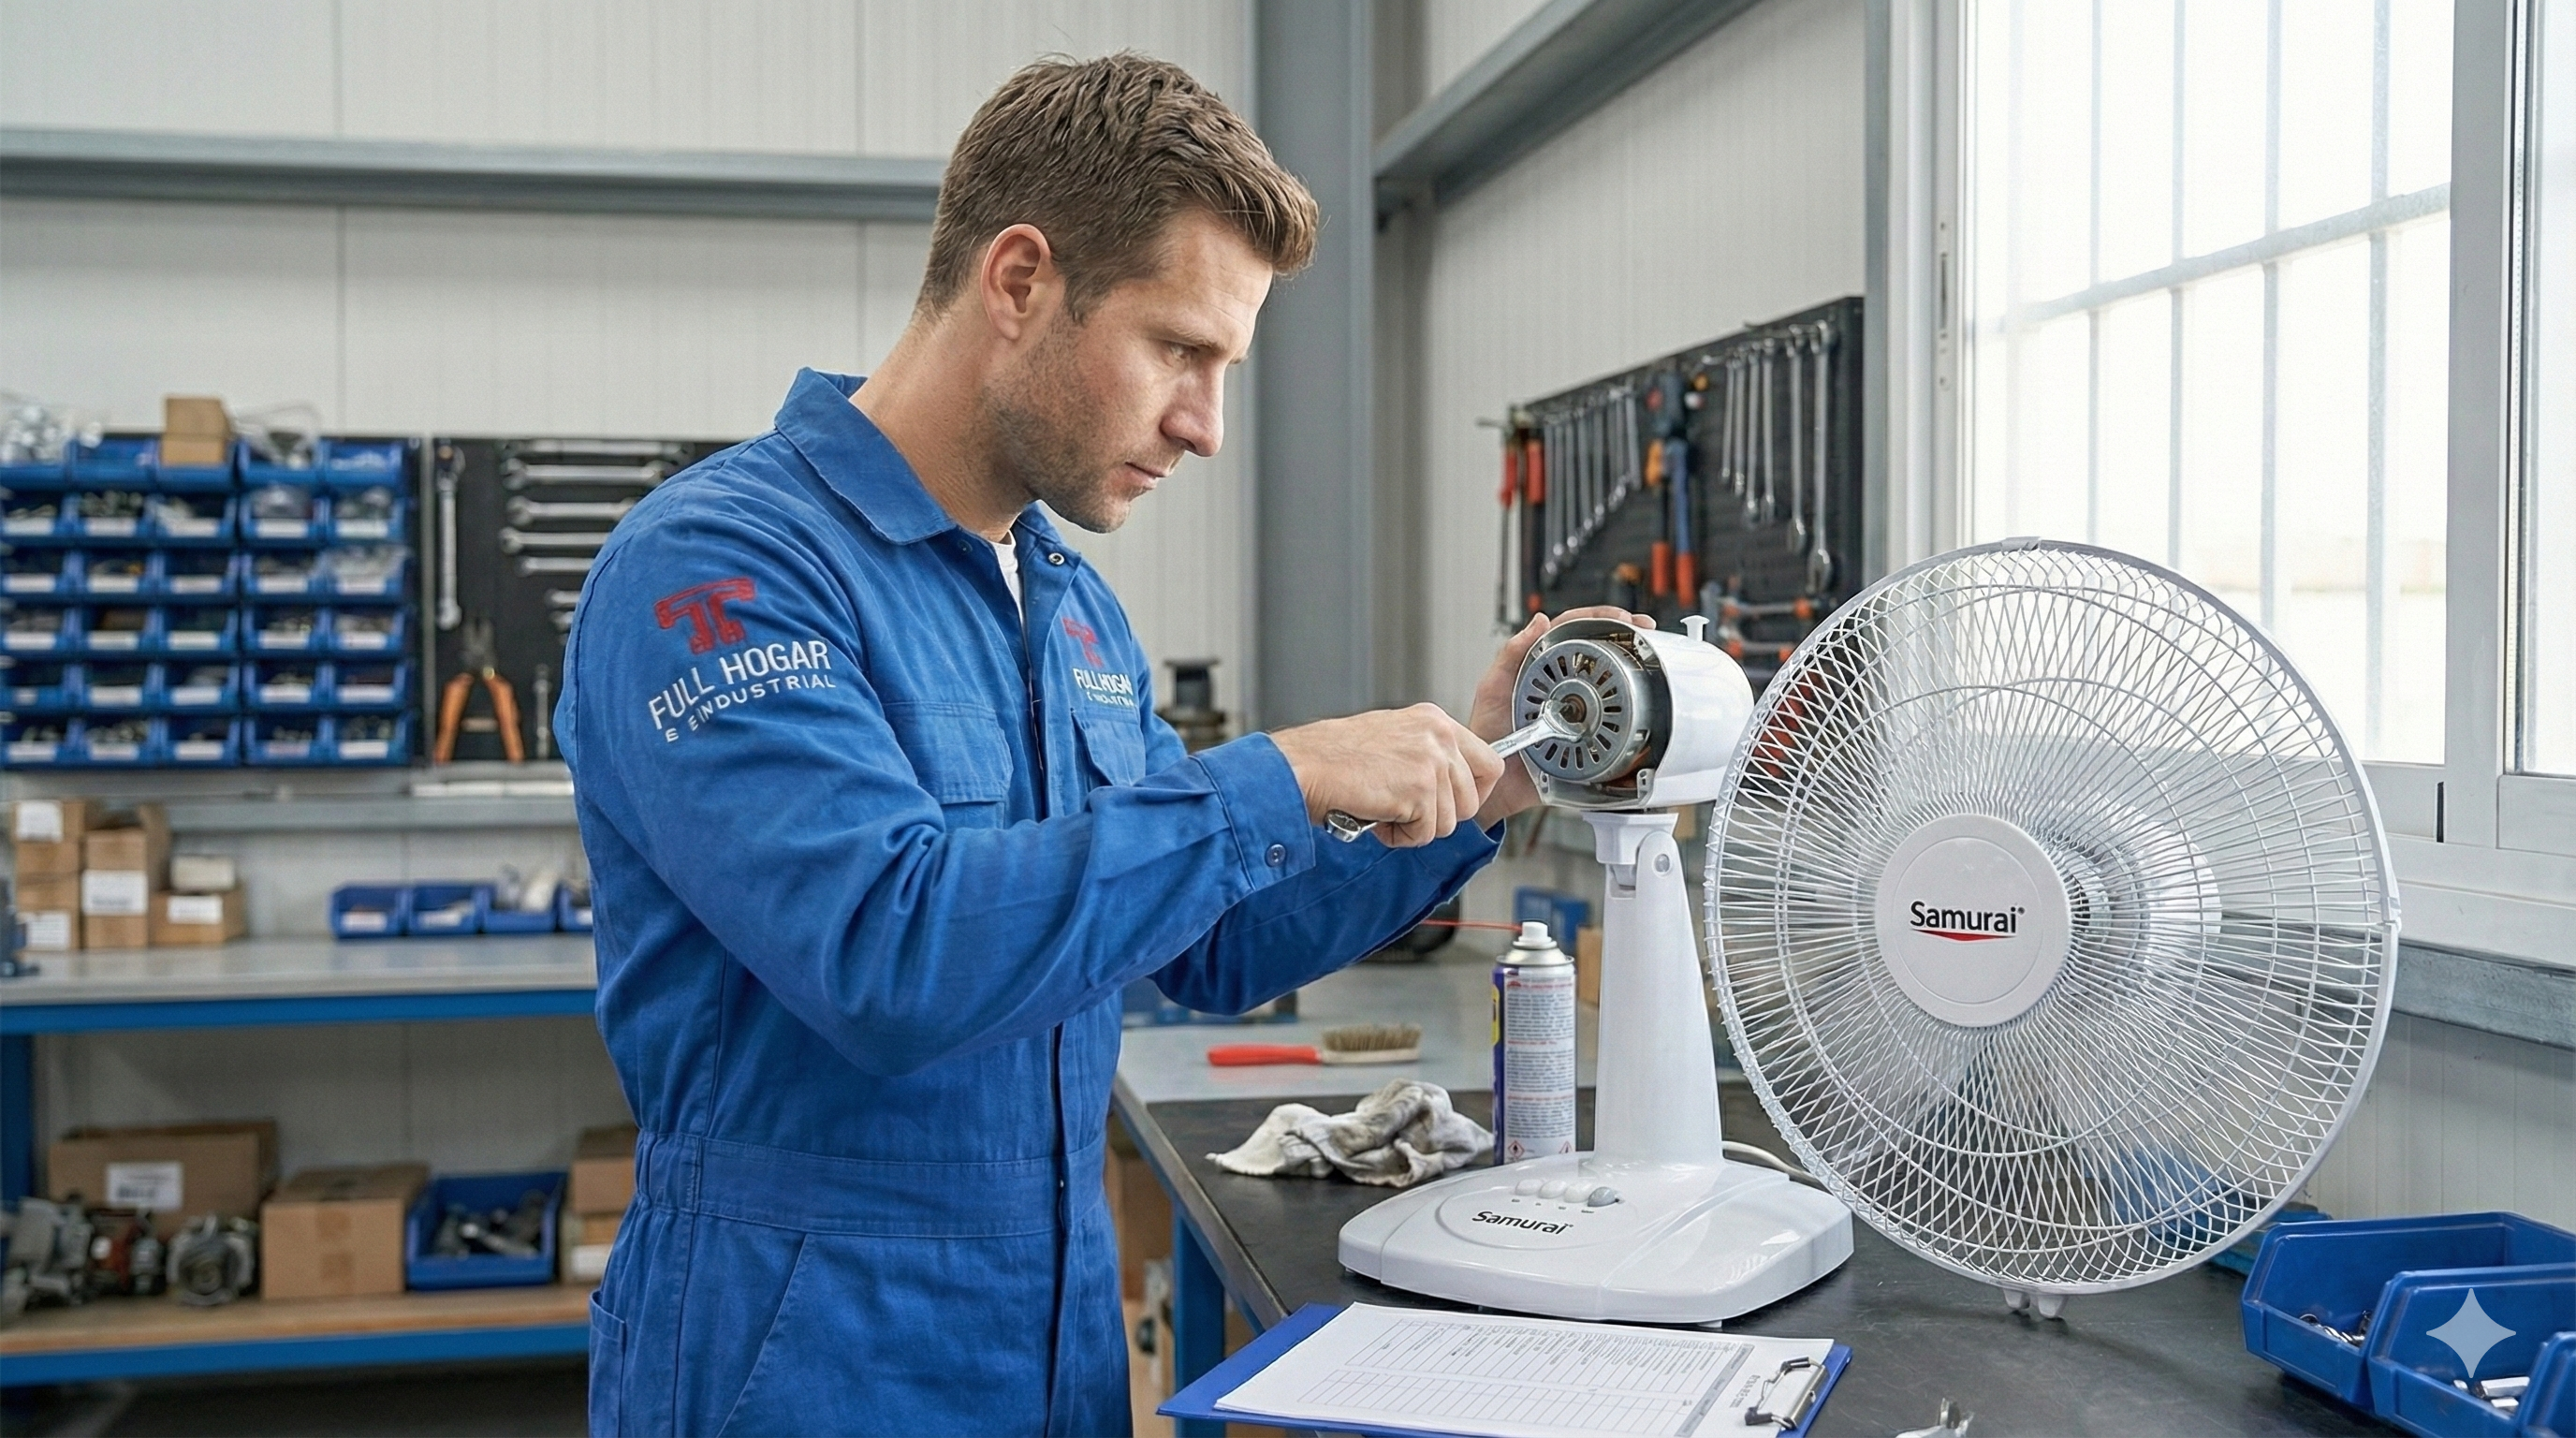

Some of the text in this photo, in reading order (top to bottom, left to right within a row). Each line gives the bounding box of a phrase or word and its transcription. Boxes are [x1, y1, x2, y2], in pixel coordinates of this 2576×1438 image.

[648, 640, 831, 730] FULL HOGAR
[1072, 668, 1103, 691] FULL
[665, 727, 680, 743] E
[1910, 901, 2016, 933] Samurai
[1471, 1211, 1570, 1235] Samurai
